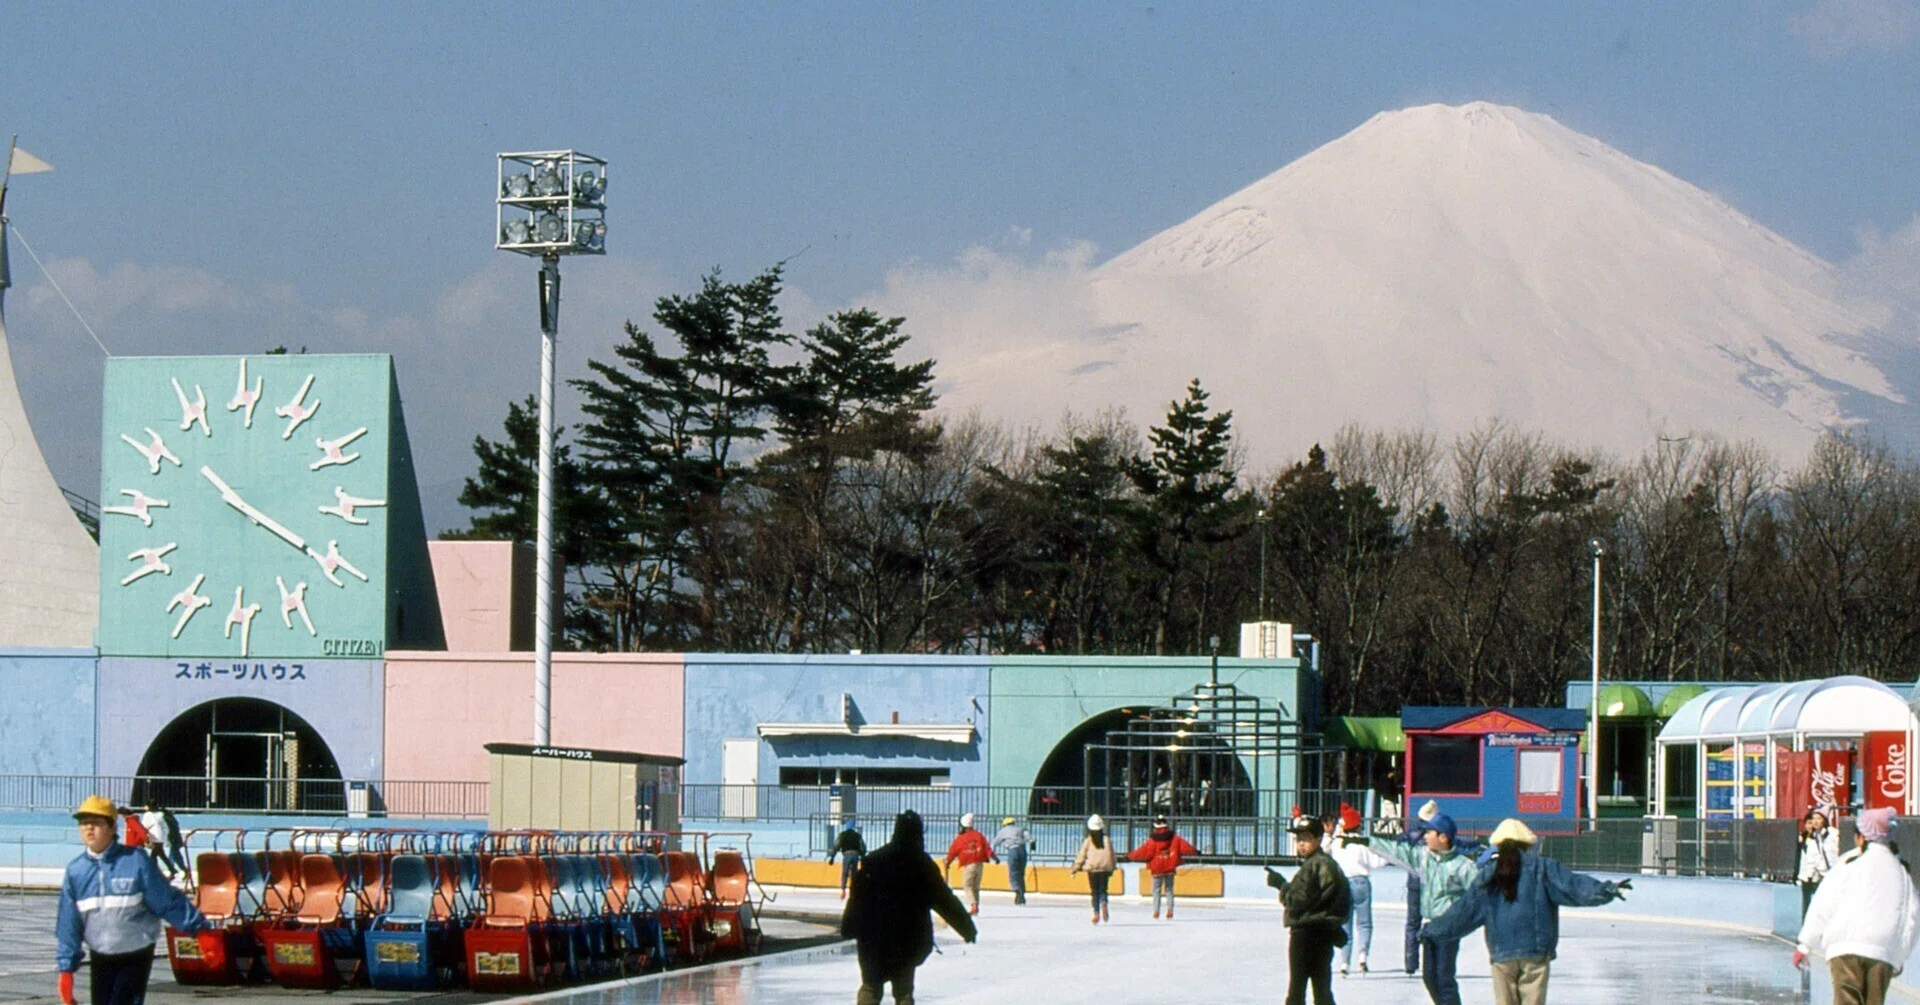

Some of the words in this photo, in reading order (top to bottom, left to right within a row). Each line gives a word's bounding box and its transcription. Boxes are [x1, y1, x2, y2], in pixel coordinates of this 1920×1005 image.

[322, 638, 384, 656] CITIZEN
[175, 662, 306, 680] スポーツハウス
[1881, 743, 1906, 798] Coke
